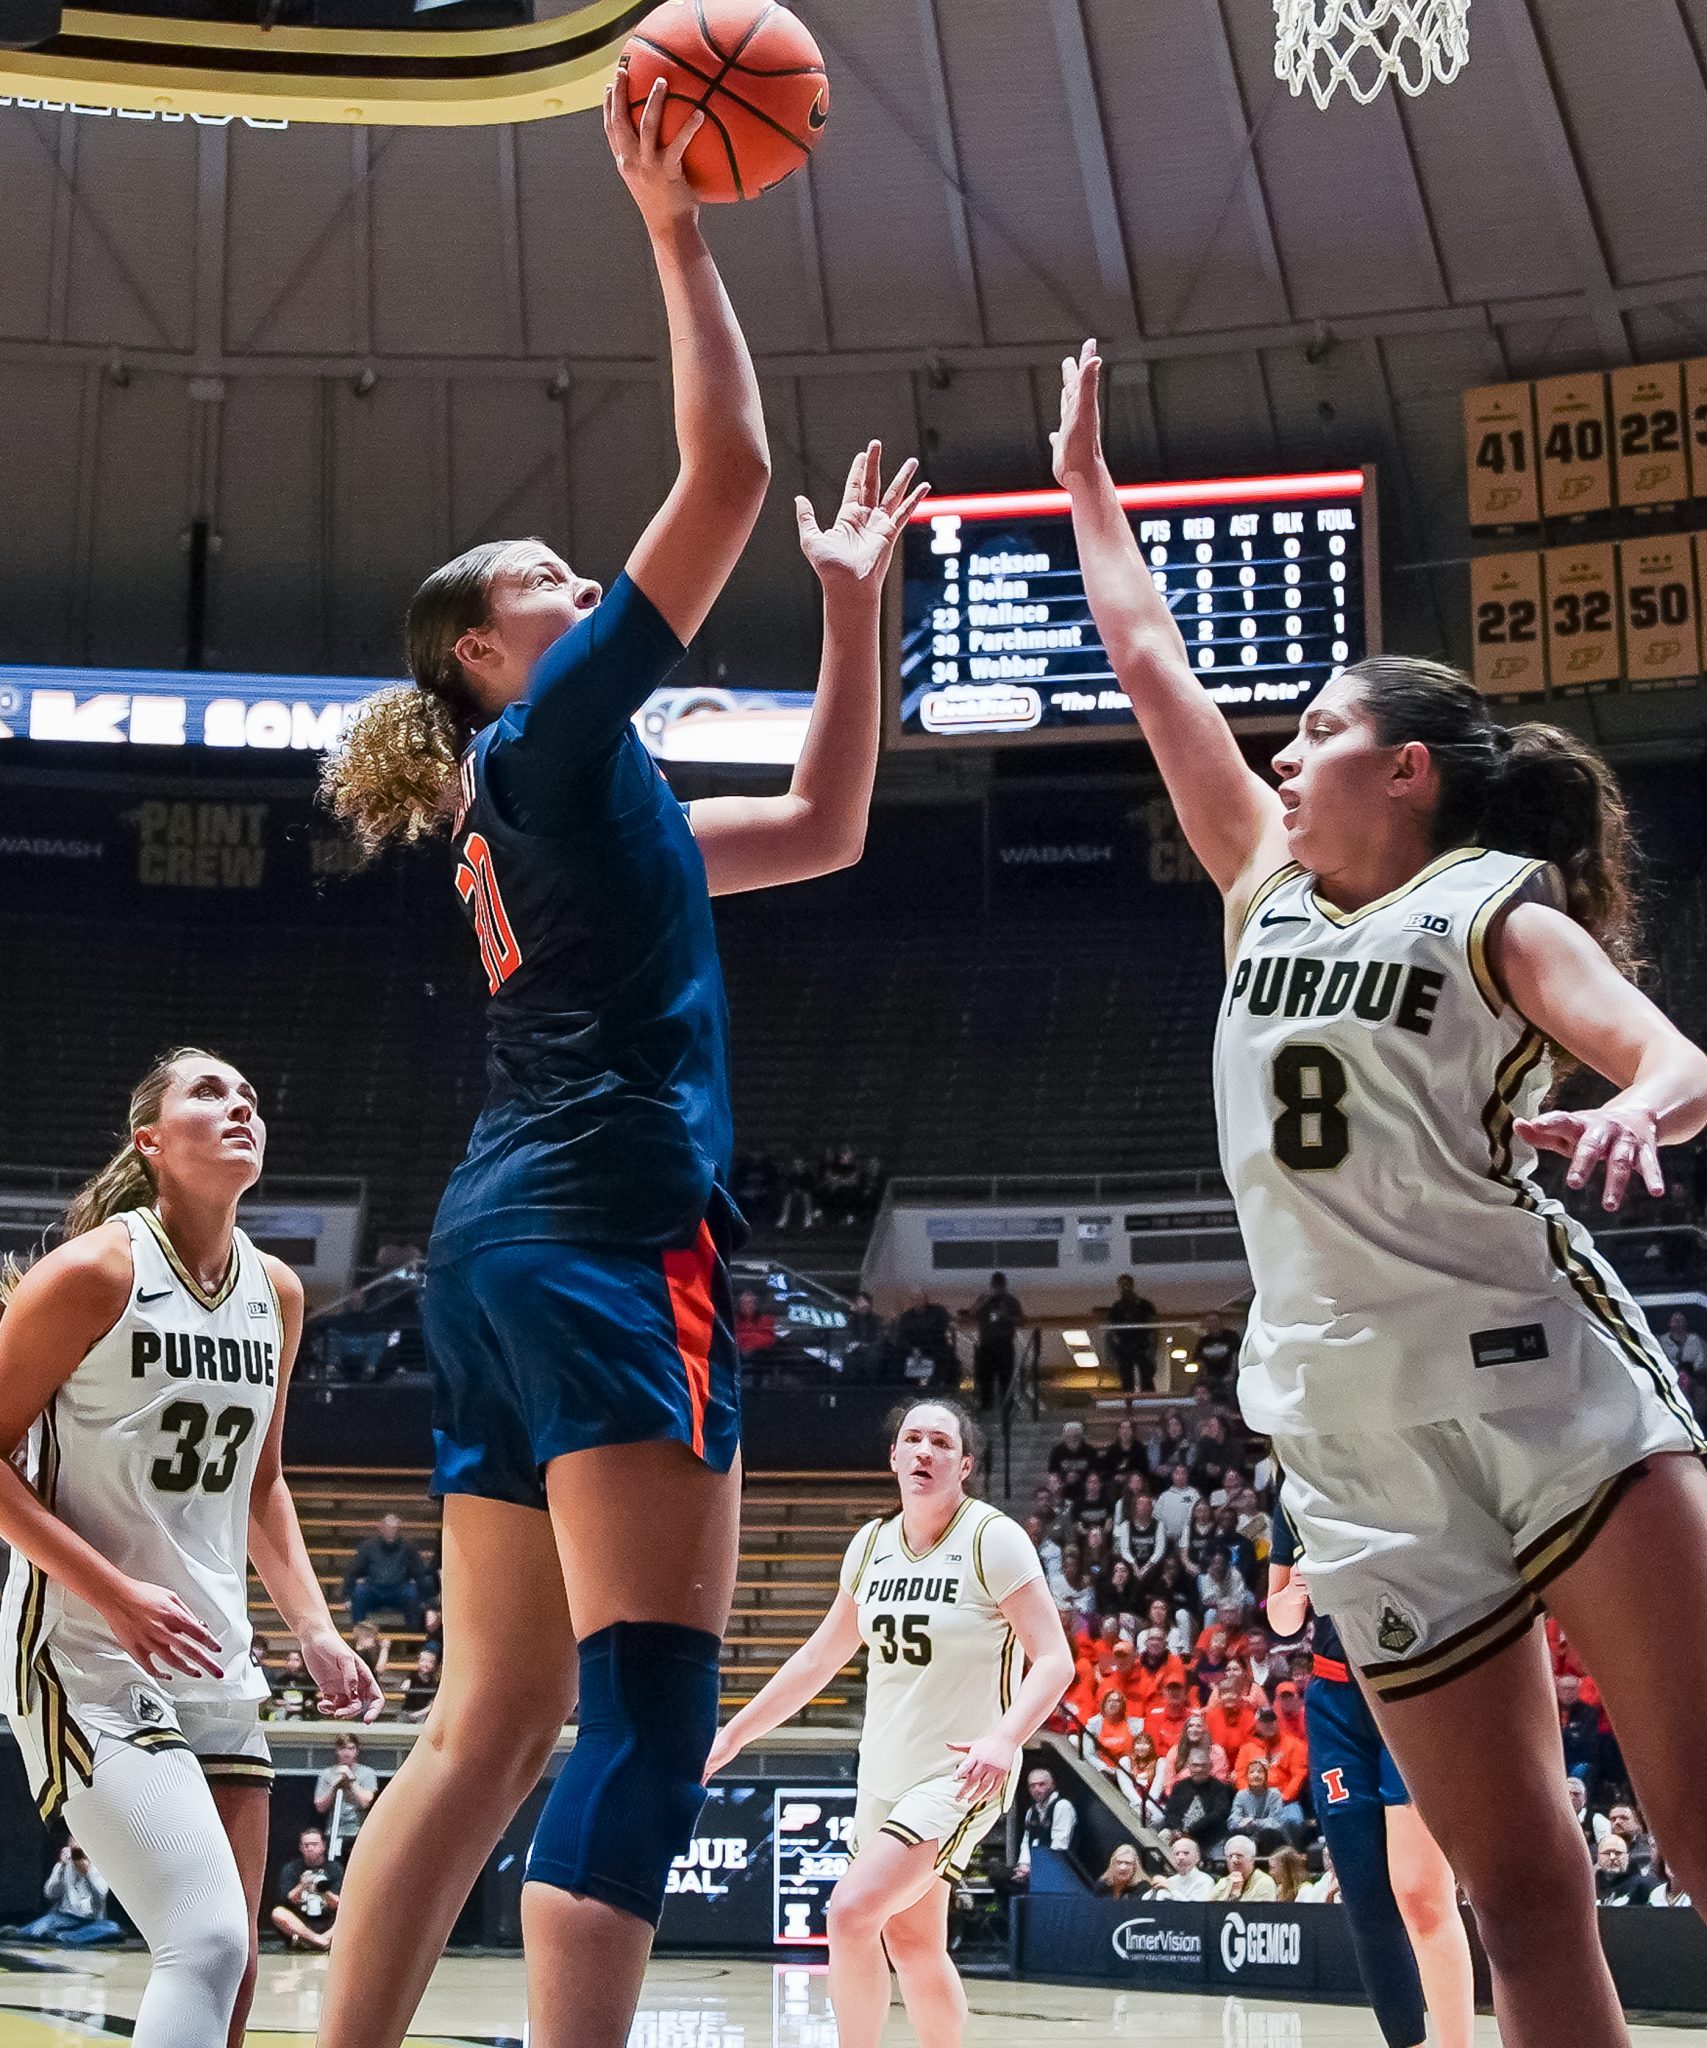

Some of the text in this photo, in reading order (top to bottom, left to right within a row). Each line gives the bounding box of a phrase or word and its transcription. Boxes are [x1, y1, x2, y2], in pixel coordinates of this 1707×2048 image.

[1476, 430, 1525, 474] 41
[1545, 419, 1602, 463] 40
[1620, 410, 1679, 455] 22
[1140, 508, 1356, 543] PTS REB AST BLK FOUL
[944, 535, 1346, 579] 2 Jackson 0 0 1 0 0
[943, 583, 960, 605] 4
[968, 578, 1028, 602] Dolan
[1196, 568, 1213, 590] 0
[1239, 566, 1256, 588] 0
[1284, 563, 1301, 585] 0
[1329, 561, 1346, 582] 0
[932, 586, 1345, 630] 23 Wallace 2 1 0 1
[1478, 601, 1536, 644] 22
[1553, 591, 1611, 636] 32
[1629, 583, 1687, 629] 50
[932, 613, 1345, 656] 30 Parchment 2 0 0 1
[932, 640, 1348, 684] 34 Webber 0 0 0 0
[137, 802, 270, 846] PAINT
[137, 846, 266, 888] CREW
[1000, 846, 1112, 864] WABASH
[1227, 956, 1445, 1036] PURDUE
[1273, 1045, 1350, 1170] 8
[132, 1331, 274, 1387] PURDUE
[151, 1401, 255, 1492] 33
[866, 1577, 959, 1604] PURDUE
[872, 1614, 932, 1666] 35
[1126, 1927, 1201, 1952] InnerVision
[1247, 1923, 1300, 1964] GEMCO
